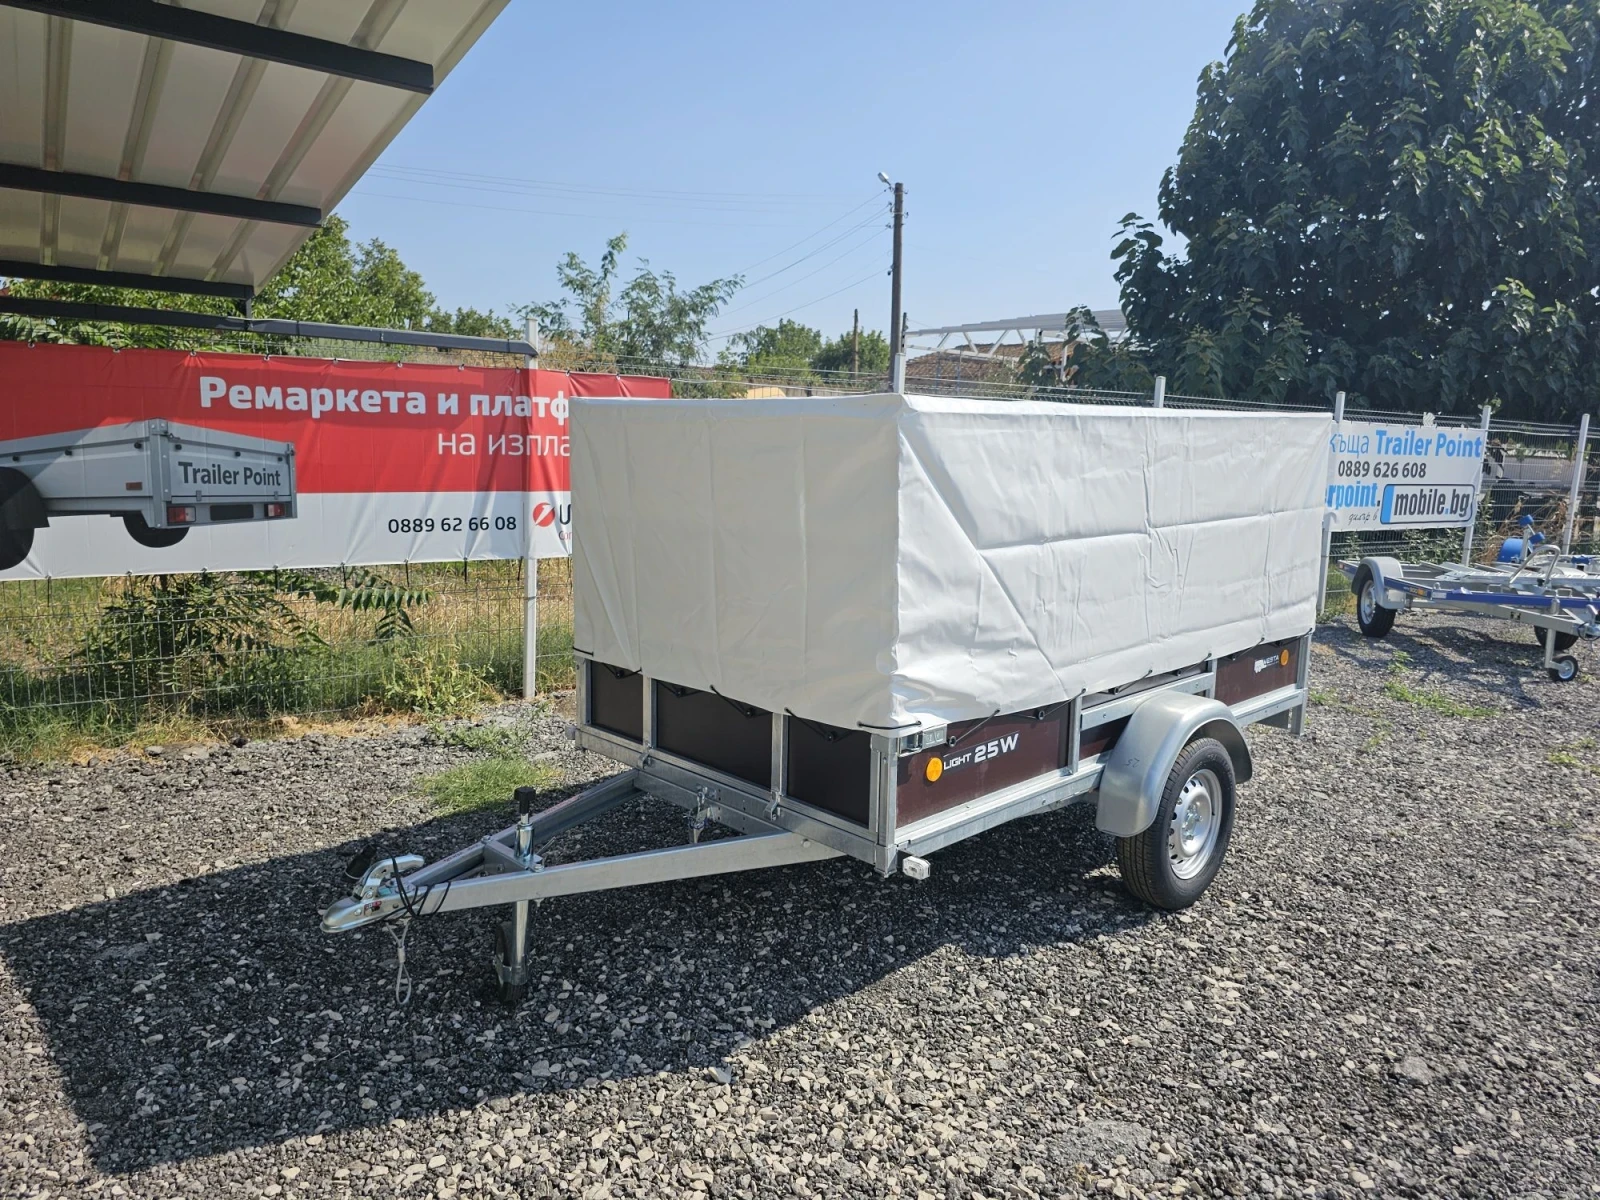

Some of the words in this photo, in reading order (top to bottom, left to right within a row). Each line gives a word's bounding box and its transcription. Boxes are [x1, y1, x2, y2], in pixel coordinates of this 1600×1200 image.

[199, 376, 427, 419] Ремаркета
[437, 393, 459, 415] и
[470, 390, 570, 426] платф
[437, 433, 476, 455] на
[1376, 430, 1433, 457] Trailer
[1435, 433, 1483, 458] Point
[182, 461, 240, 486] Trailer
[243, 466, 282, 488] Point
[1338, 460, 1371, 478] 0889
[1373, 462, 1399, 479] 626
[1401, 462, 1427, 479] 608
[1394, 488, 1470, 518] mobile.bg
[387, 517, 436, 534] 0889
[440, 517, 463, 533] 62
[467, 516, 490, 531] 66
[494, 515, 518, 531] 08
[943, 752, 972, 770] LIGHT
